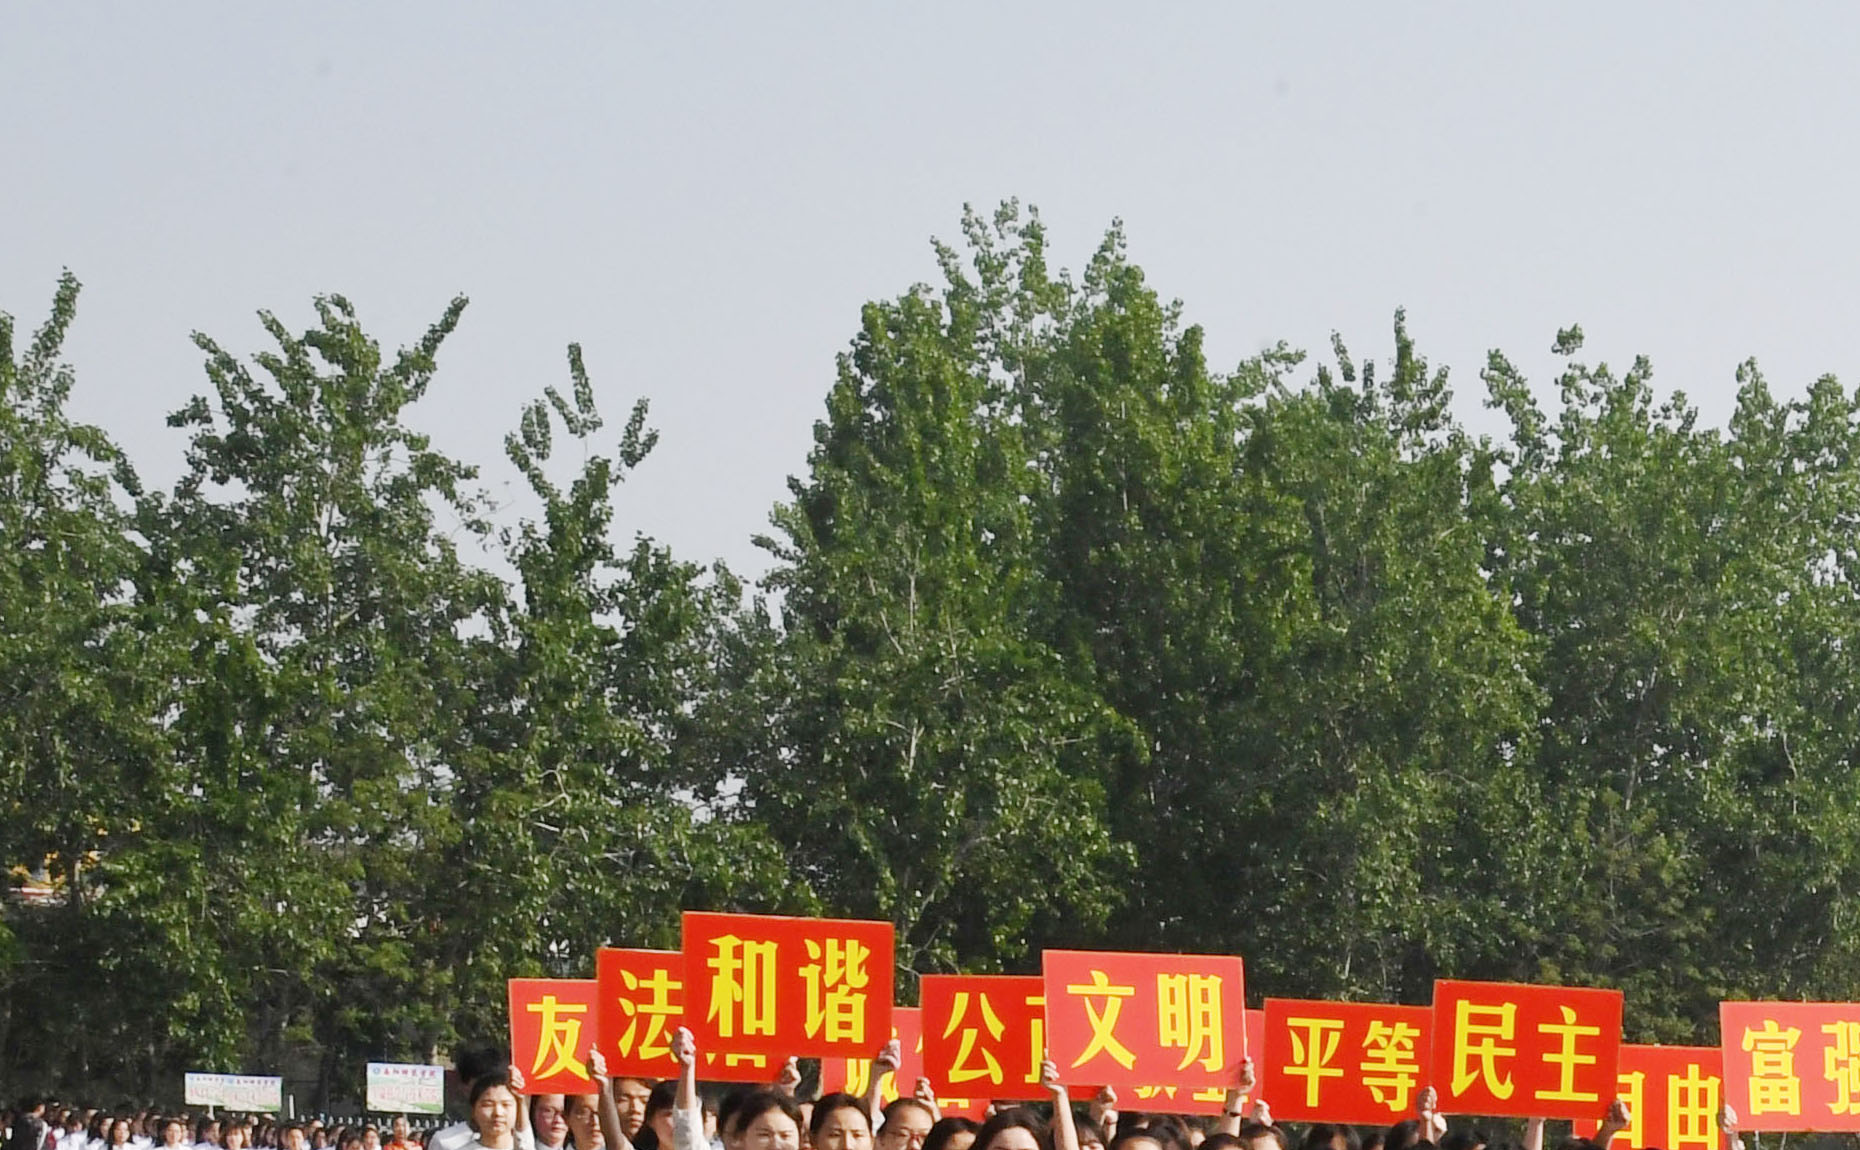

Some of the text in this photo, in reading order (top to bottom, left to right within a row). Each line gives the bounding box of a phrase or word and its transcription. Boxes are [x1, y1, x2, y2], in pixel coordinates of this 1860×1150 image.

[706, 934, 870, 1044] 和谐
[1066, 970, 1225, 1073] 文明
[1283, 1017, 1421, 1112] 平等
[1451, 999, 1601, 1102] 民主
